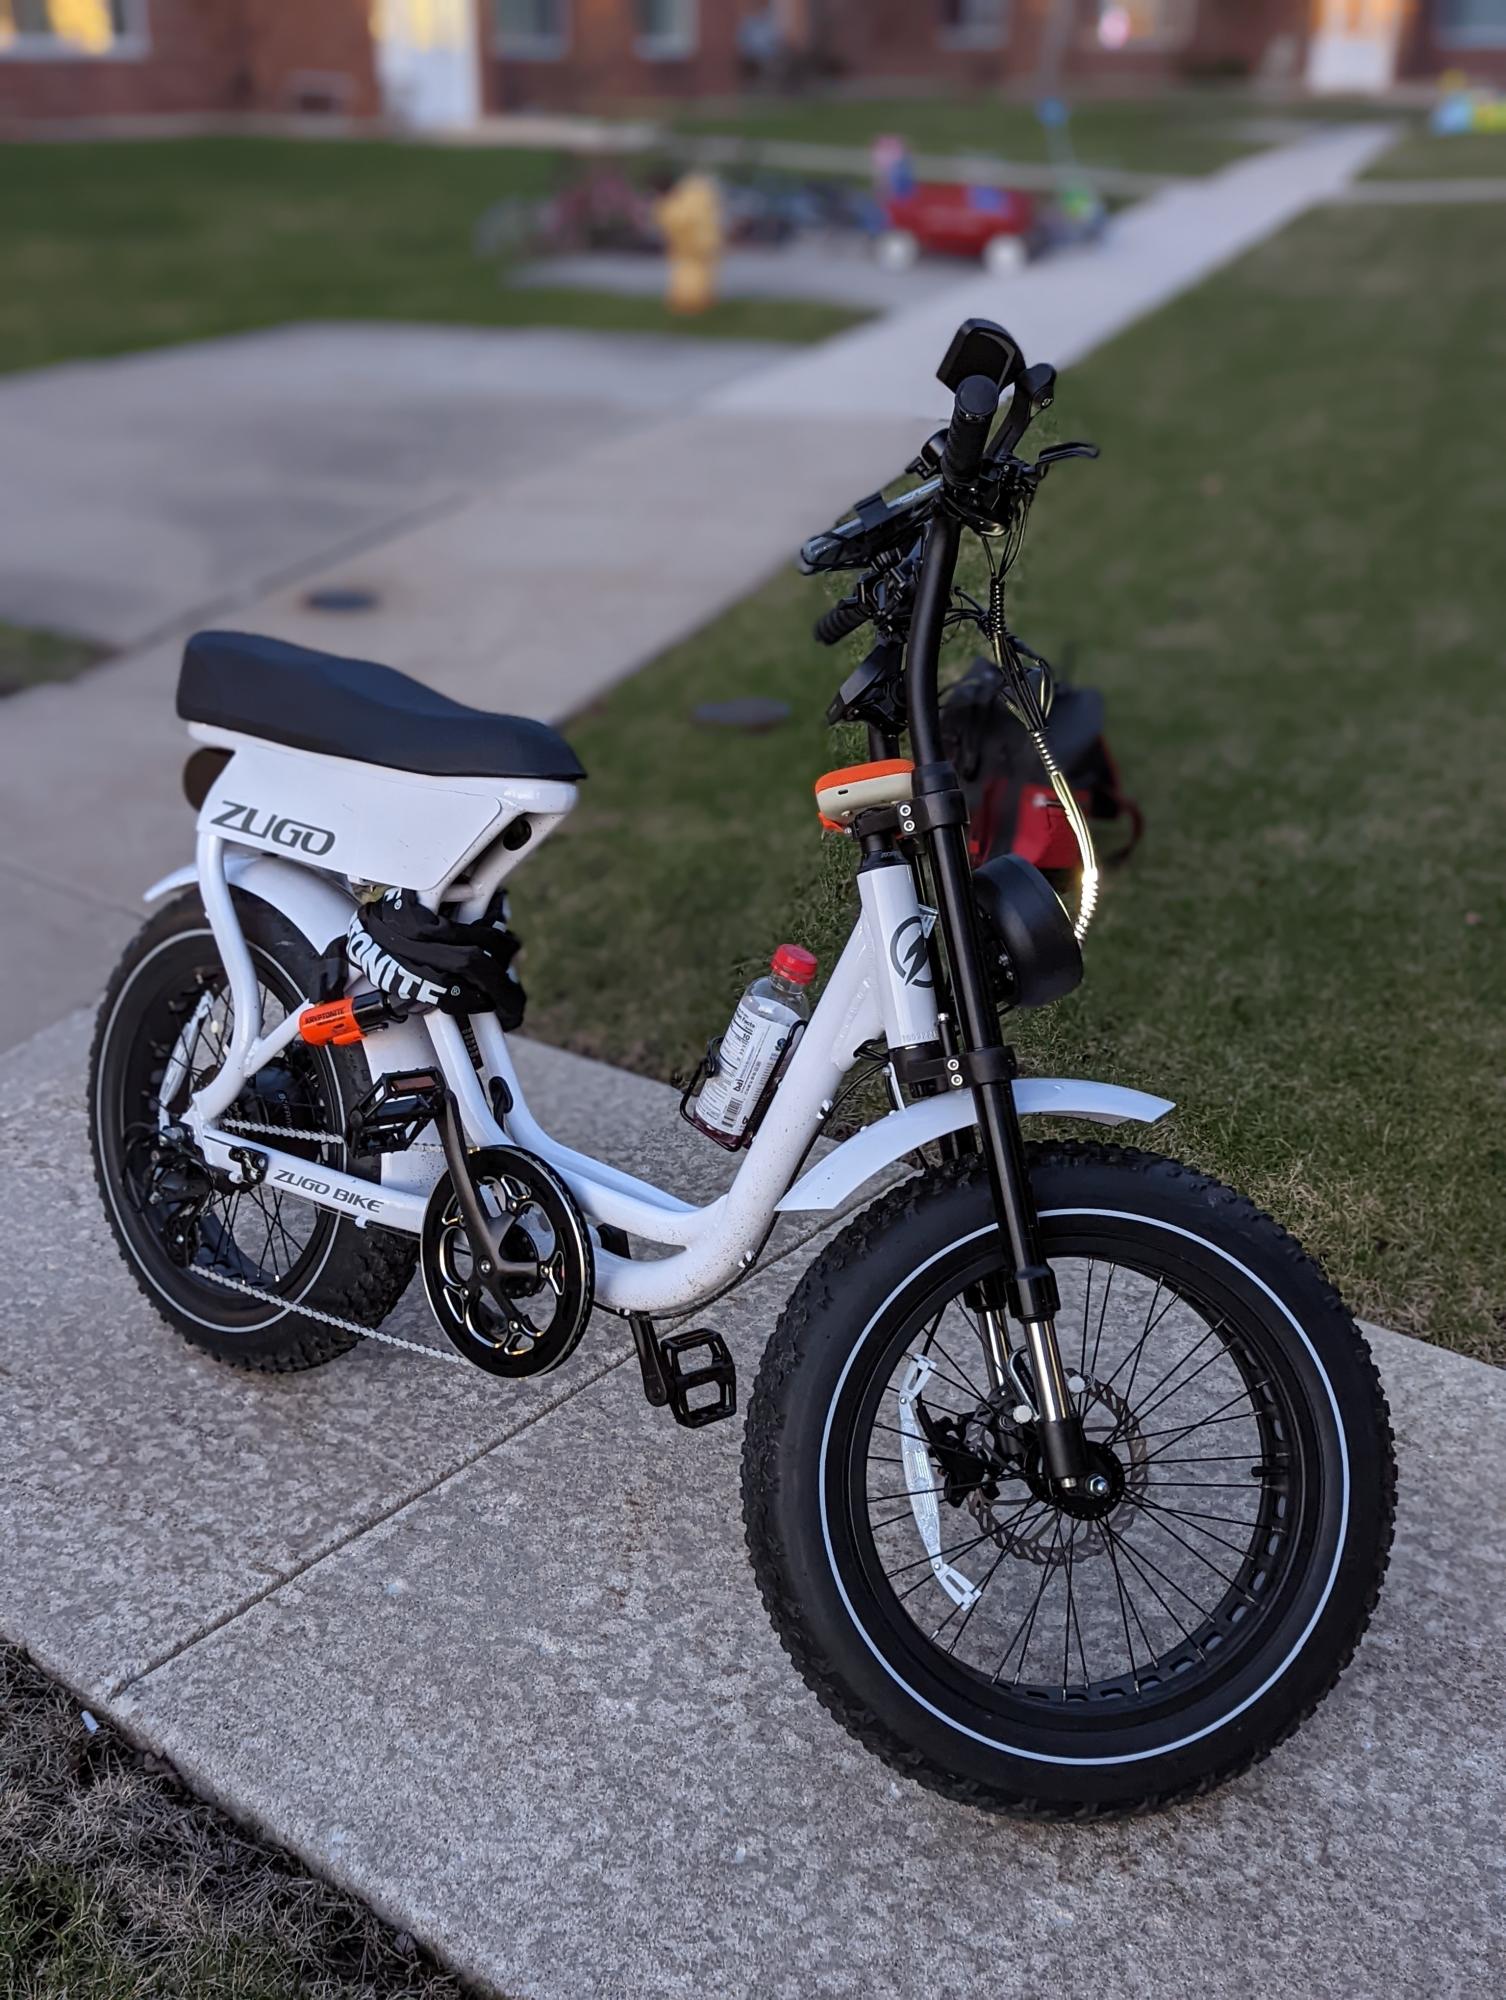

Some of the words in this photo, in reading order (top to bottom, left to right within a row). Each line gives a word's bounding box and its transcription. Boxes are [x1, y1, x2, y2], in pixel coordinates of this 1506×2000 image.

[210, 800, 335, 856] ZUGO
[273, 1169, 331, 1195] ZUGO
[332, 1188, 384, 1213] BIKE
